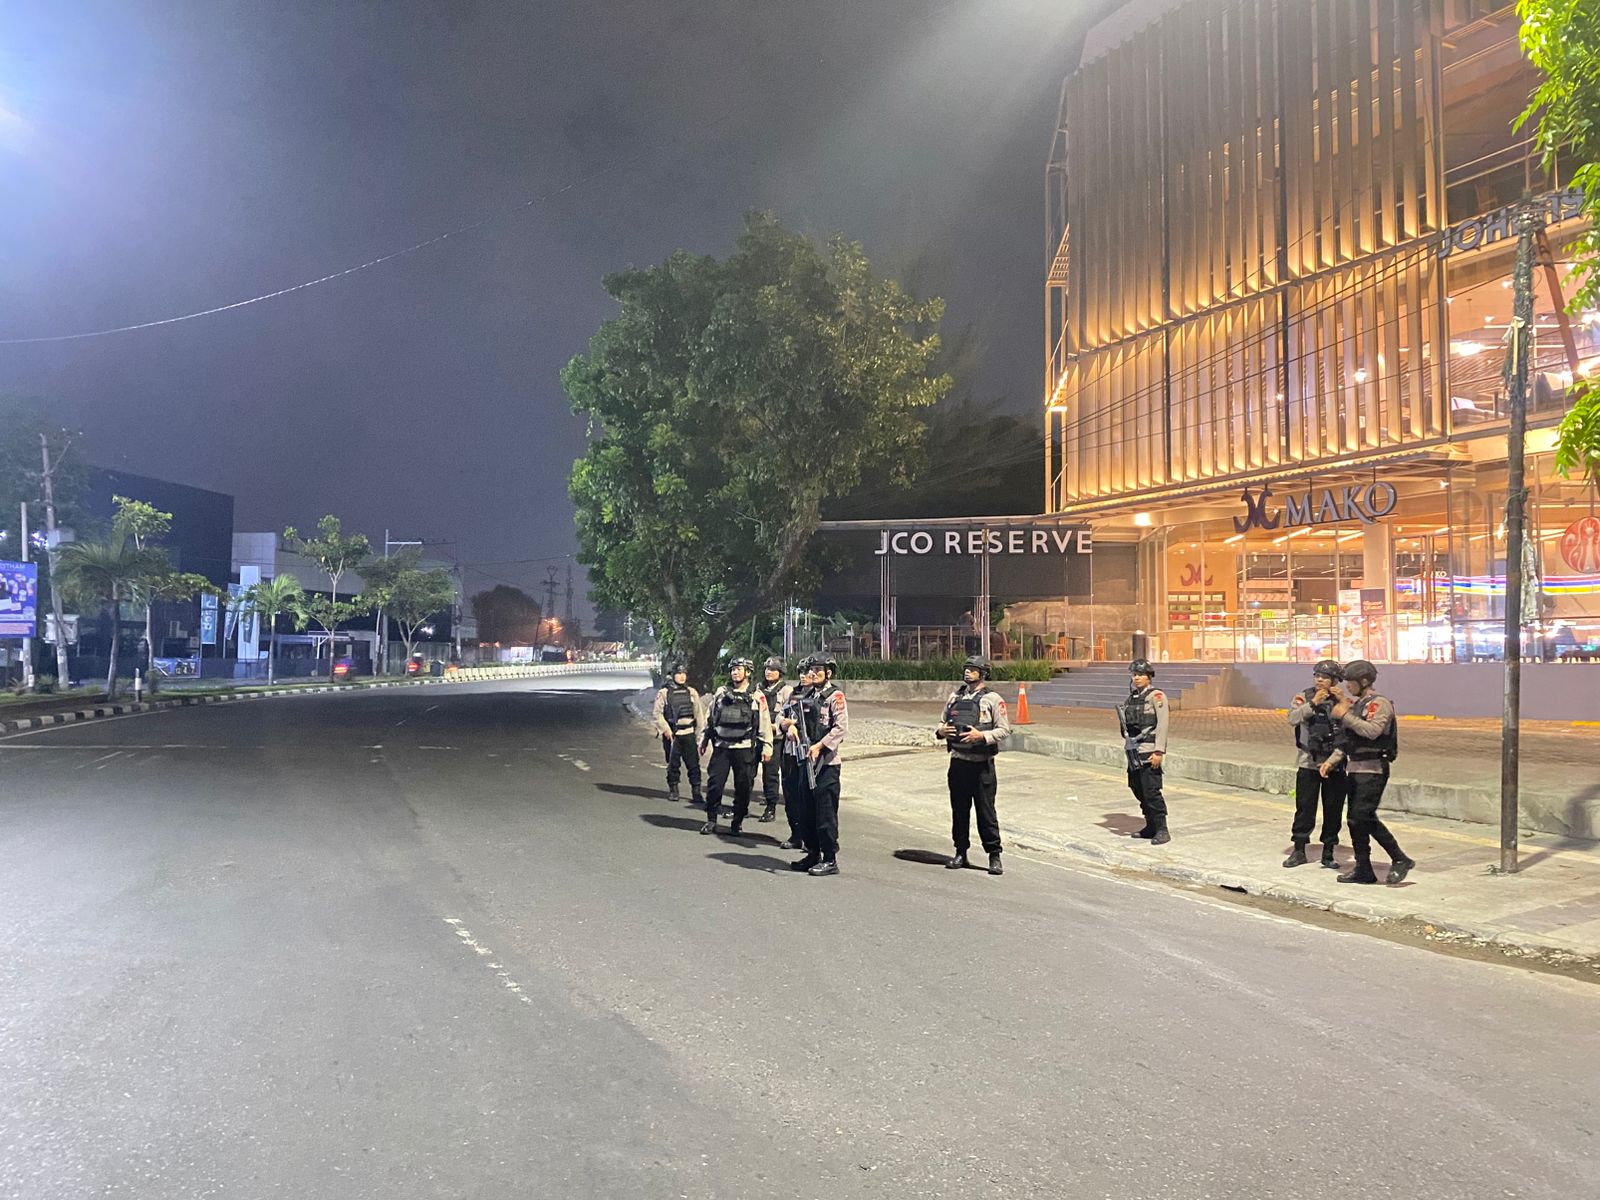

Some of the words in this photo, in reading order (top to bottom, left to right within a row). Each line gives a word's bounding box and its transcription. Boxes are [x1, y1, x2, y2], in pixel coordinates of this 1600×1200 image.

[1285, 481, 1398, 525] MAKO
[874, 531, 934, 555] JCO
[945, 530, 1093, 554] RESERVE
